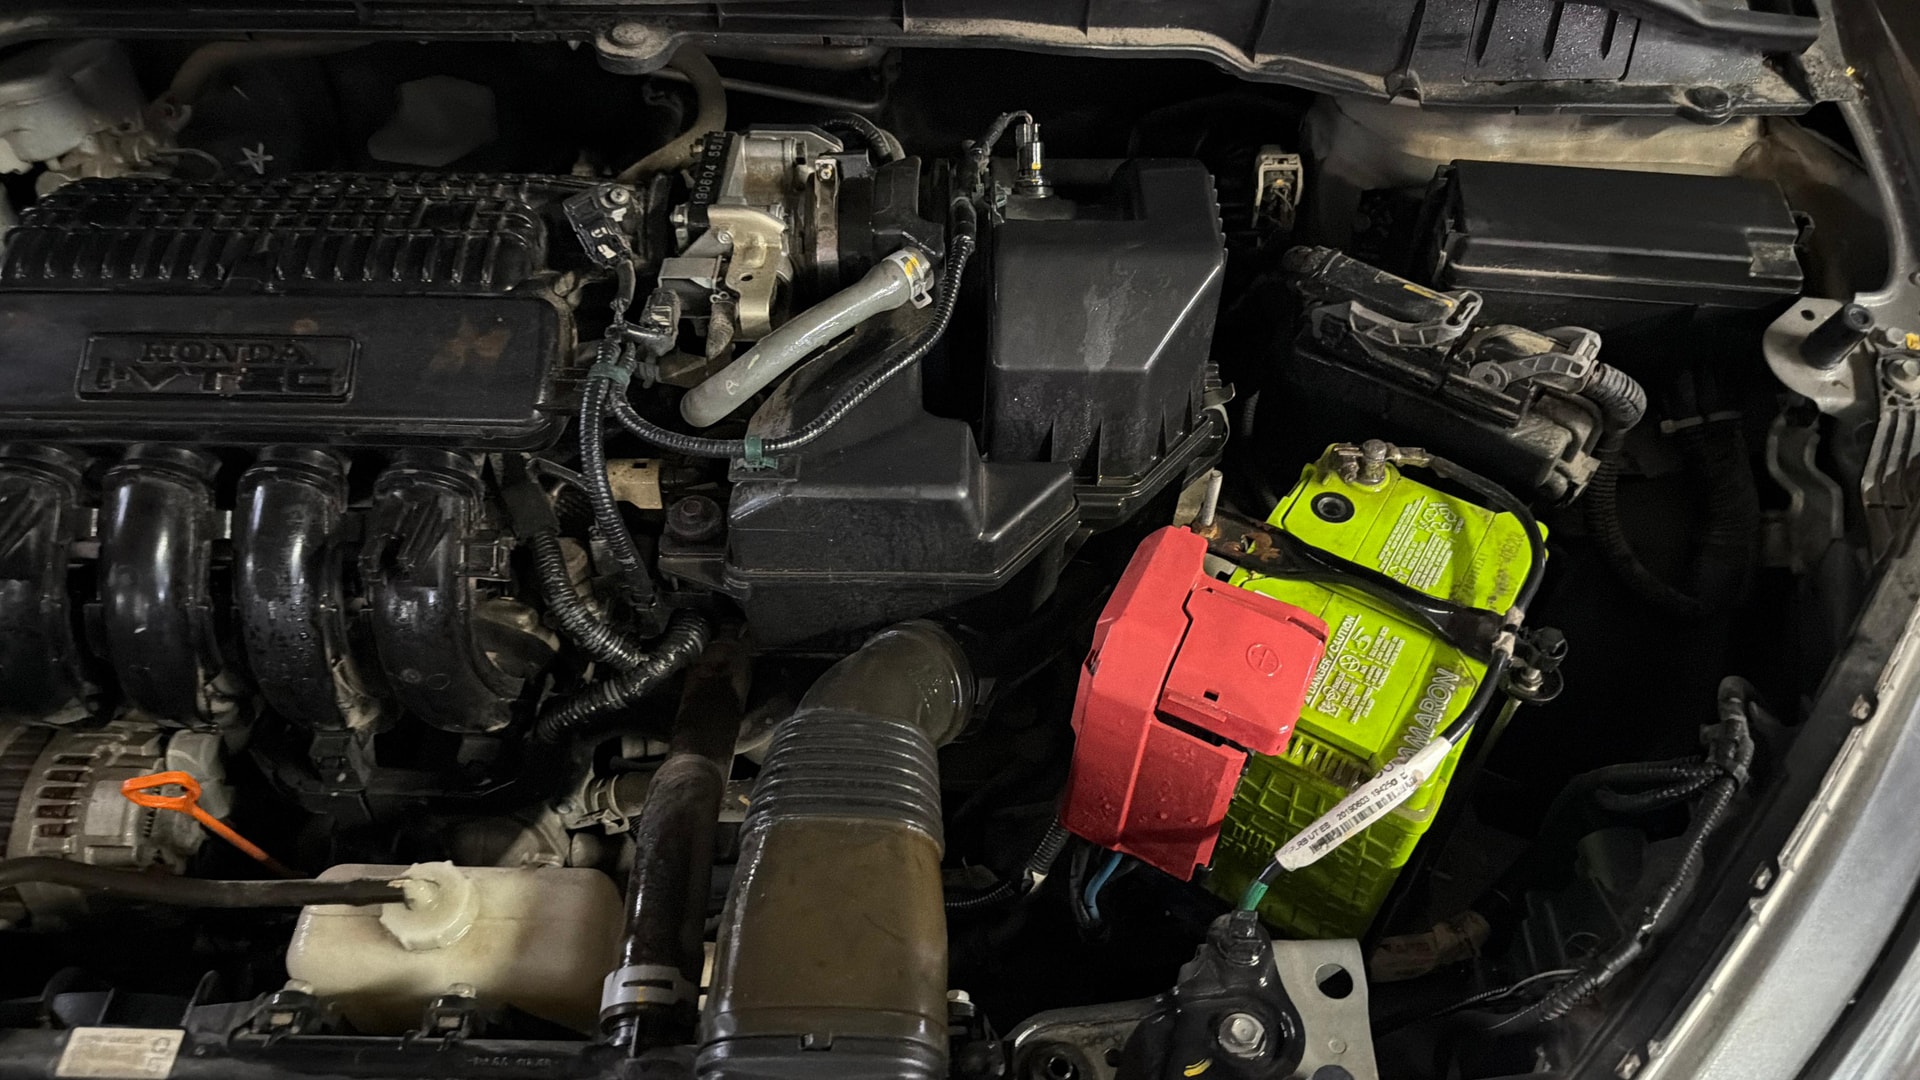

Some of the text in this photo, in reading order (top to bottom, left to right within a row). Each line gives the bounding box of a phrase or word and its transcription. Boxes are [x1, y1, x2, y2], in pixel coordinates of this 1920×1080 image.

[135, 341, 313, 365] HONDA
[1308, 658, 1332, 694] DANGER
[1329, 616, 1356, 652] CAUTION
